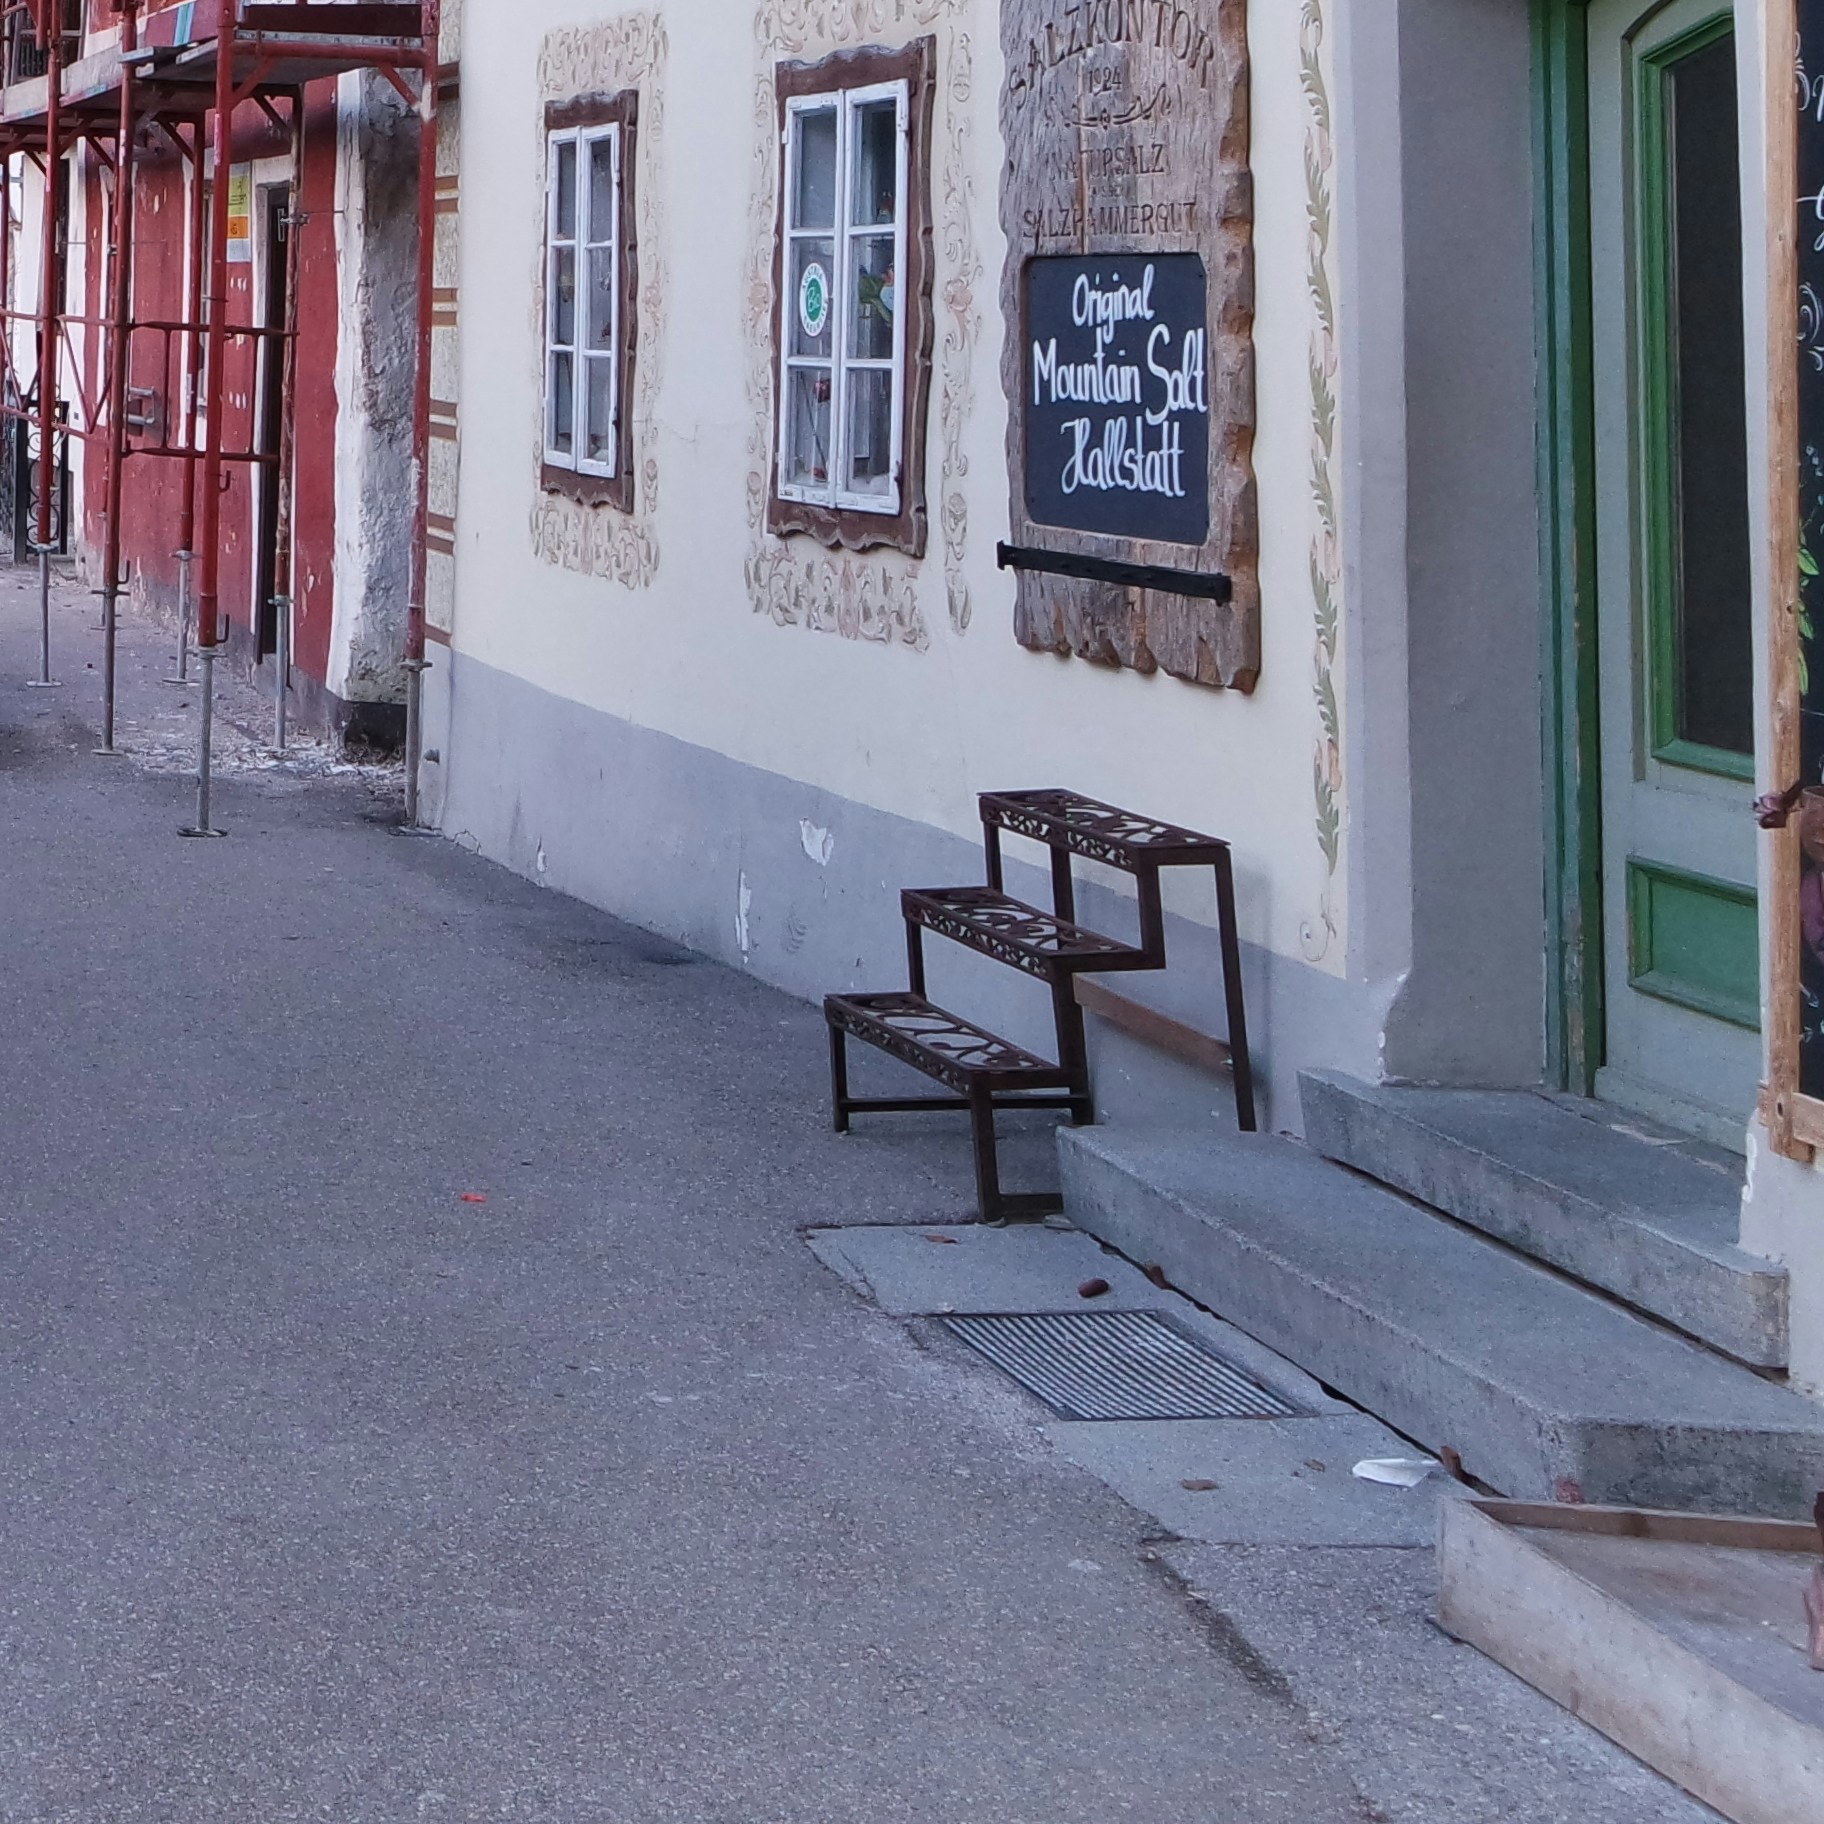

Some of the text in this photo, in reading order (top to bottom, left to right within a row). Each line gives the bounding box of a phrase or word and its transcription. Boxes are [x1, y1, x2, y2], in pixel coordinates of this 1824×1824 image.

[1072, 263, 1155, 344] Original
[1033, 323, 1208, 426] Mountain Salt
[1060, 415, 1185, 497] Hallstatt
